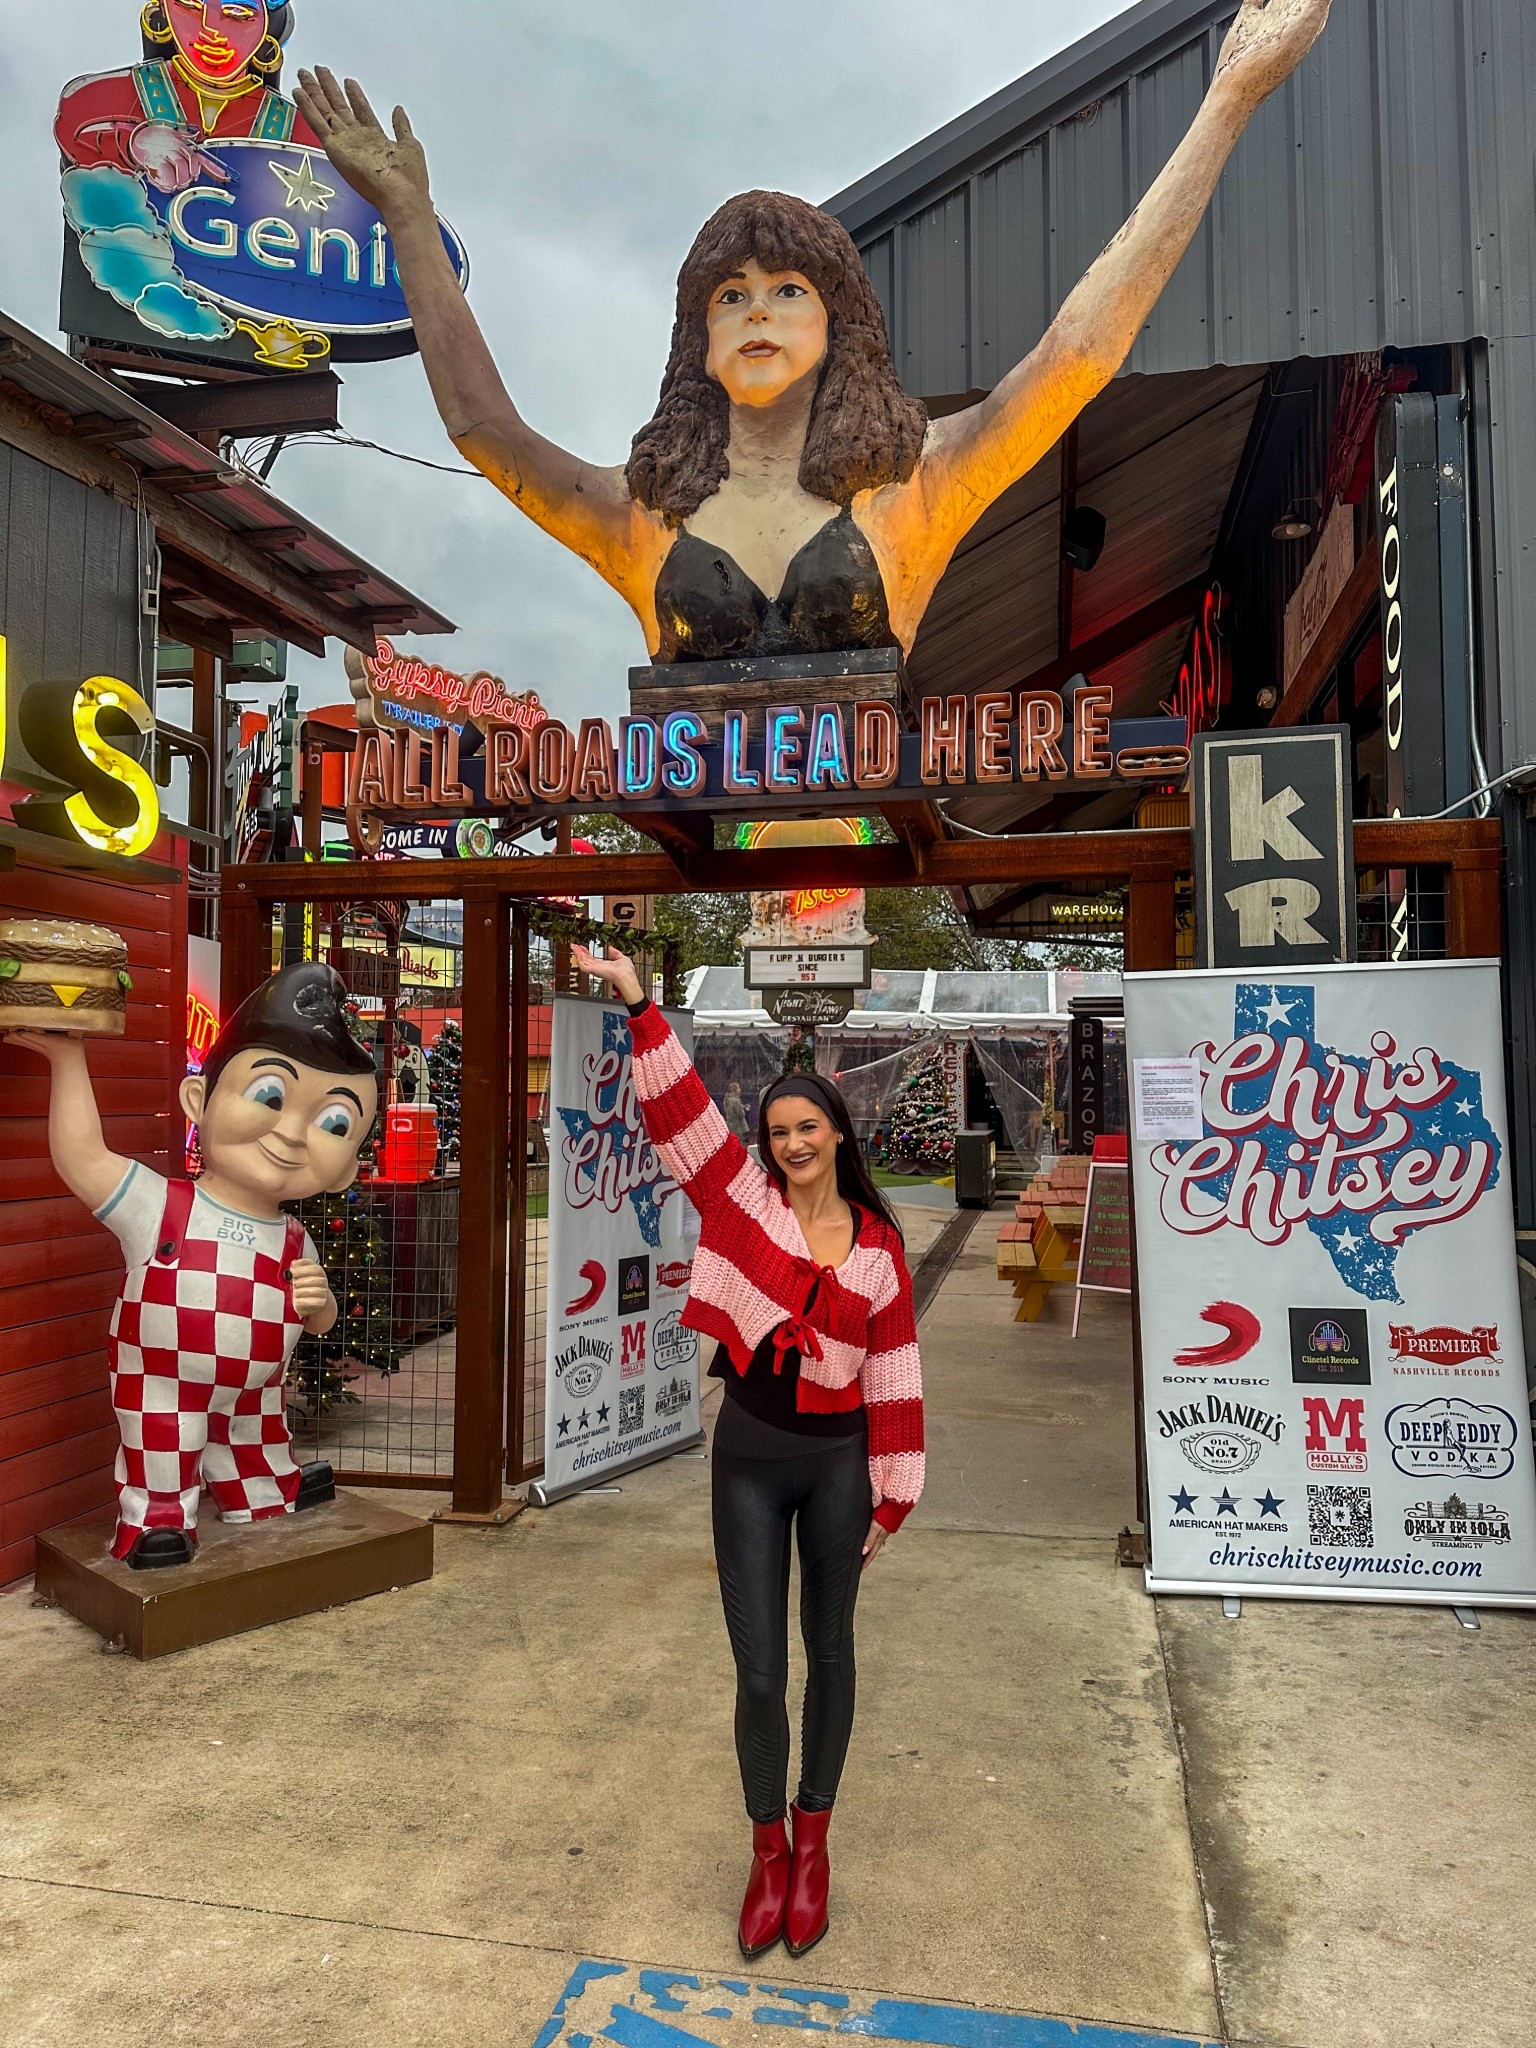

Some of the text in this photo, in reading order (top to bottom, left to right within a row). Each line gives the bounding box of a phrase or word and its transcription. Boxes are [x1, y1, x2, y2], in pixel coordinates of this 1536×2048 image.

[169, 186, 403, 287] Geni
[1379, 457, 1402, 751] FOOD
[367, 639, 547, 728] Gypsy Picnic
[381, 699, 441, 729] TRAILER
[351, 726, 474, 807] ALL
[485, 711, 708, 805] ROADS
[723, 701, 896, 793] LEAD
[921, 686, 1112, 785] HERE
[428, 829, 448, 845] IN
[1052, 904, 1124, 916] WAREHOUS
[808, 953, 845, 962] BURGERS
[350, 954, 399, 990] VALET
[772, 998, 804, 1014] NIGHT
[1081, 1022, 1096, 1146] BRAZOS
[1190, 1031, 1458, 1140] Chris
[1150, 1112, 1494, 1246] Chitsey
[223, 1217, 254, 1234] BIG
[217, 1227, 256, 1245] BOY
[662, 1268, 691, 1281] PREMIER
[559, 1316, 609, 1332] SONY MUSIC
[621, 1320, 646, 1366] M
[1407, 1339, 1481, 1353] PREMIER
[554, 1335, 614, 1378] JACK DANIEL'S
[1330, 1356, 1359, 1365] Records
[622, 1363, 644, 1374] MOLLY'S
[1393, 1367, 1500, 1377] NASHVILLE RECORDS
[1213, 1377, 1270, 1386] MUSIC
[1156, 1395, 1287, 1442] JACK DANIEL'S
[1303, 1397, 1367, 1452] M
[1400, 1422, 1501, 1443] DEEP EDDY
[572, 1420, 682, 1471] chrischitseymusic.com
[1210, 1438, 1229, 1446] Old
[1203, 1446, 1238, 1458] No.7
[1311, 1454, 1363, 1464] MOLLY'S
[1411, 1450, 1496, 1463] VODKA
[1169, 1519, 1289, 1532] AMERICAN HAT MAKERS
[1404, 1519, 1511, 1540] ONLY IN IOLA
[1209, 1543, 1483, 1578] chrischitseymusic.com
